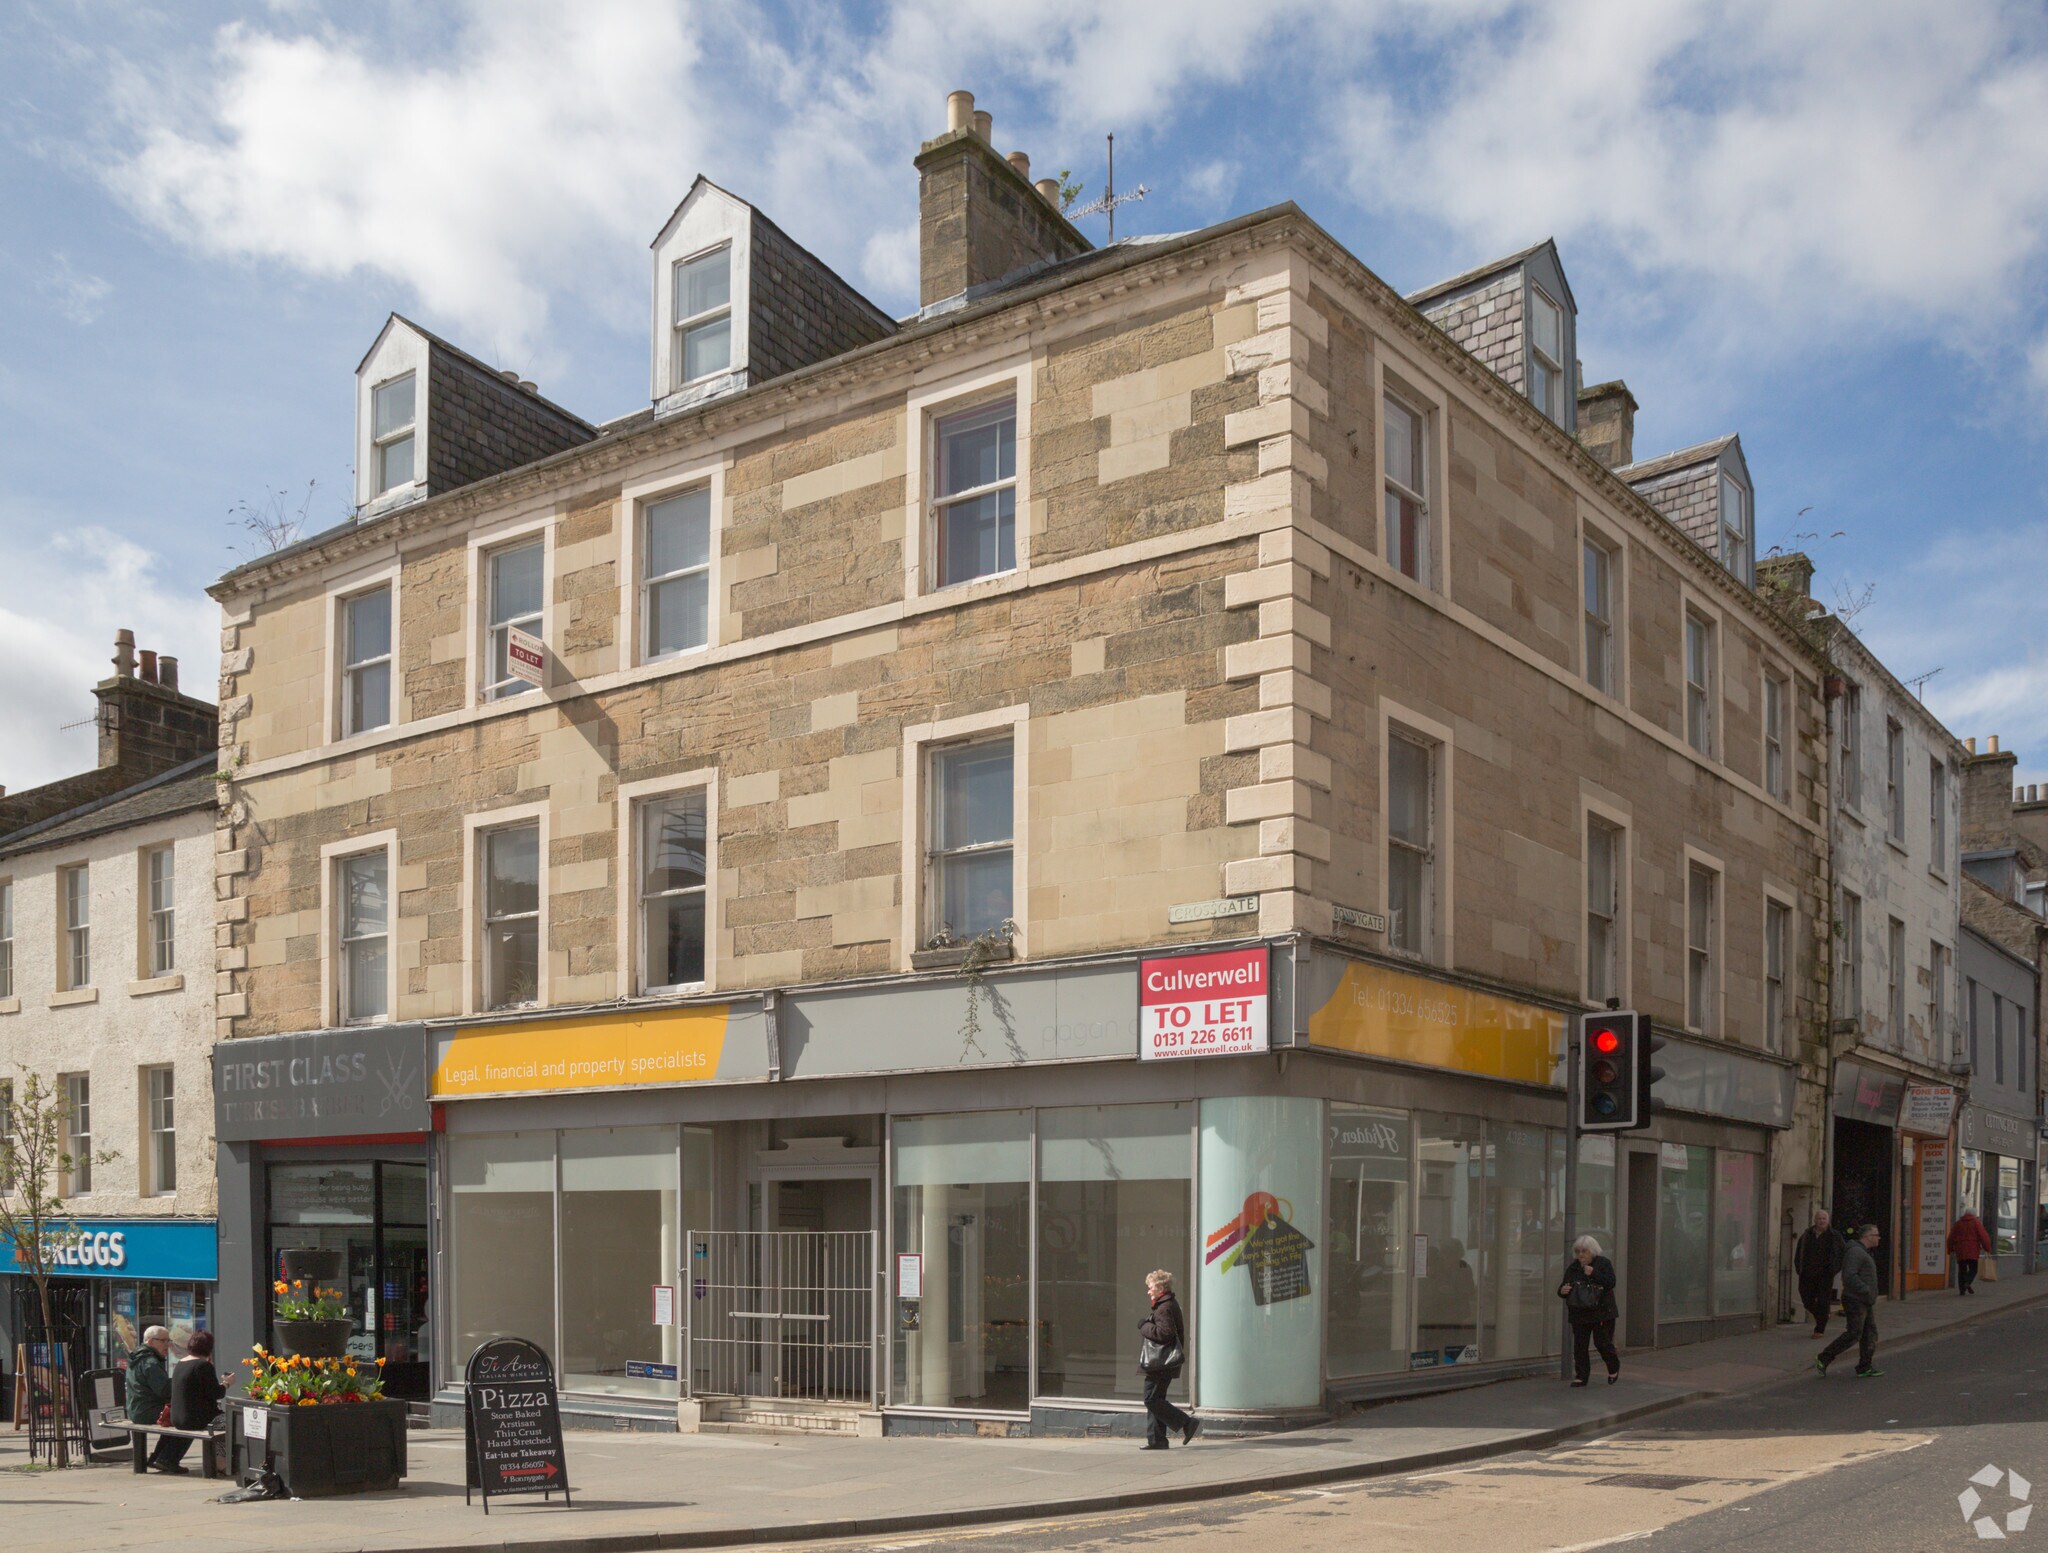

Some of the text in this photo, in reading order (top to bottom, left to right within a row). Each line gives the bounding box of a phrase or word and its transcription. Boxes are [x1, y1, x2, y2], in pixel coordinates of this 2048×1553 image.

[515, 648, 538, 664] TO LET
[1174, 898, 1254, 920] CROSSGATE
[1334, 906, 1384, 930] BONNYGATE
[1147, 962, 1260, 992] Culverwell
[1351, 982, 1458, 1026] Tel: 01334 656525
[1154, 1005, 1191, 1028] TO
[1204, 1000, 1252, 1026] LET
[1154, 1026, 1252, 1048] 0131 226 6611
[1154, 1042, 1252, 1058] www.culverwell.co.uk
[222, 1052, 366, 1092] FIRST CLASS
[445, 1050, 706, 1086] Legal, financial and property specialists
[1271, 1244, 1296, 1254] buying
[347, 1342, 374, 1350] rbers
[502, 1355, 540, 1372] Amo
[479, 1388, 549, 1410] Pizza
[491, 1410, 541, 1420] Stone Baked
[500, 1420, 536, 1429] Arstisan
[494, 1428, 542, 1438] Thin Crust
[487, 1436, 552, 1448] Hand Stretched
[485, 1452, 510, 1460] Eat-in
[520, 1449, 556, 1457] Takeaway
[500, 1462, 520, 1470] 01334
[510, 1475, 545, 1483] Bonnygate
